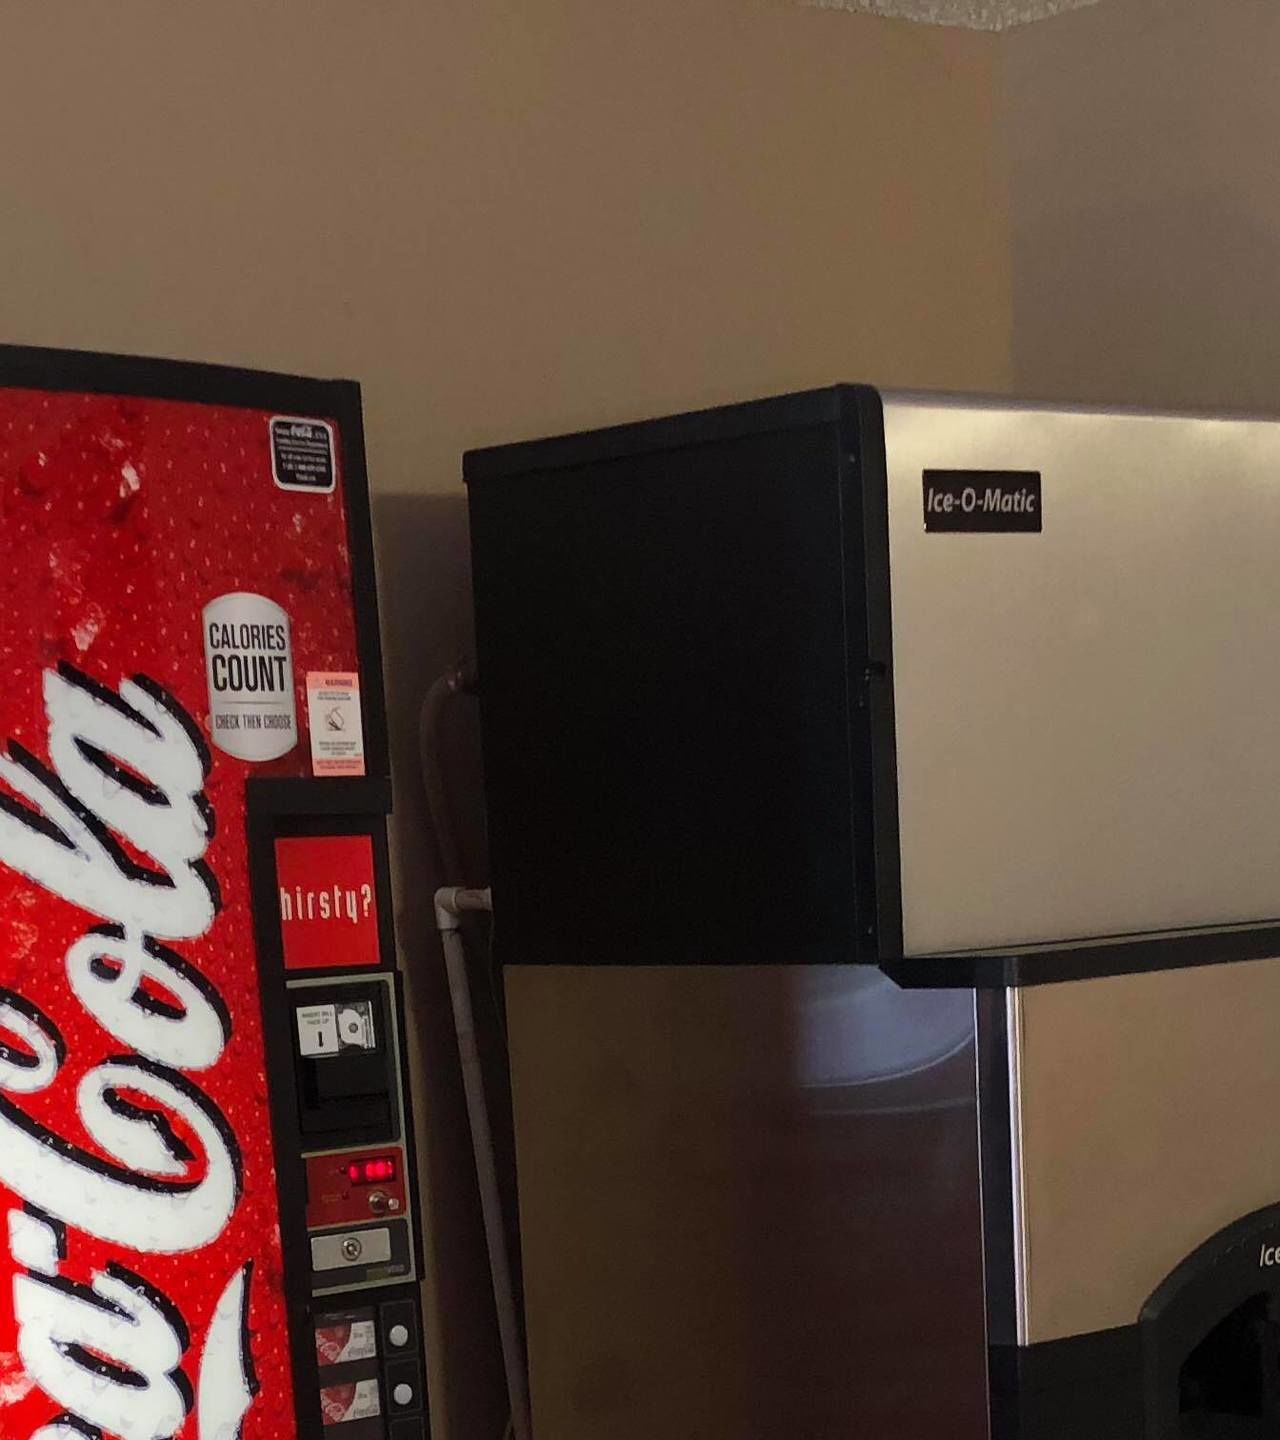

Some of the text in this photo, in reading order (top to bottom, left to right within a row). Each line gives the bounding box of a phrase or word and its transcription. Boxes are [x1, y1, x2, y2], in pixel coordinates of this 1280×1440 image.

[927, 487, 1035, 512] Ice-O-Matic
[209, 623, 286, 650] CALORIES
[212, 654, 287, 692] COUNT
[243, 714, 261, 729] THEN
